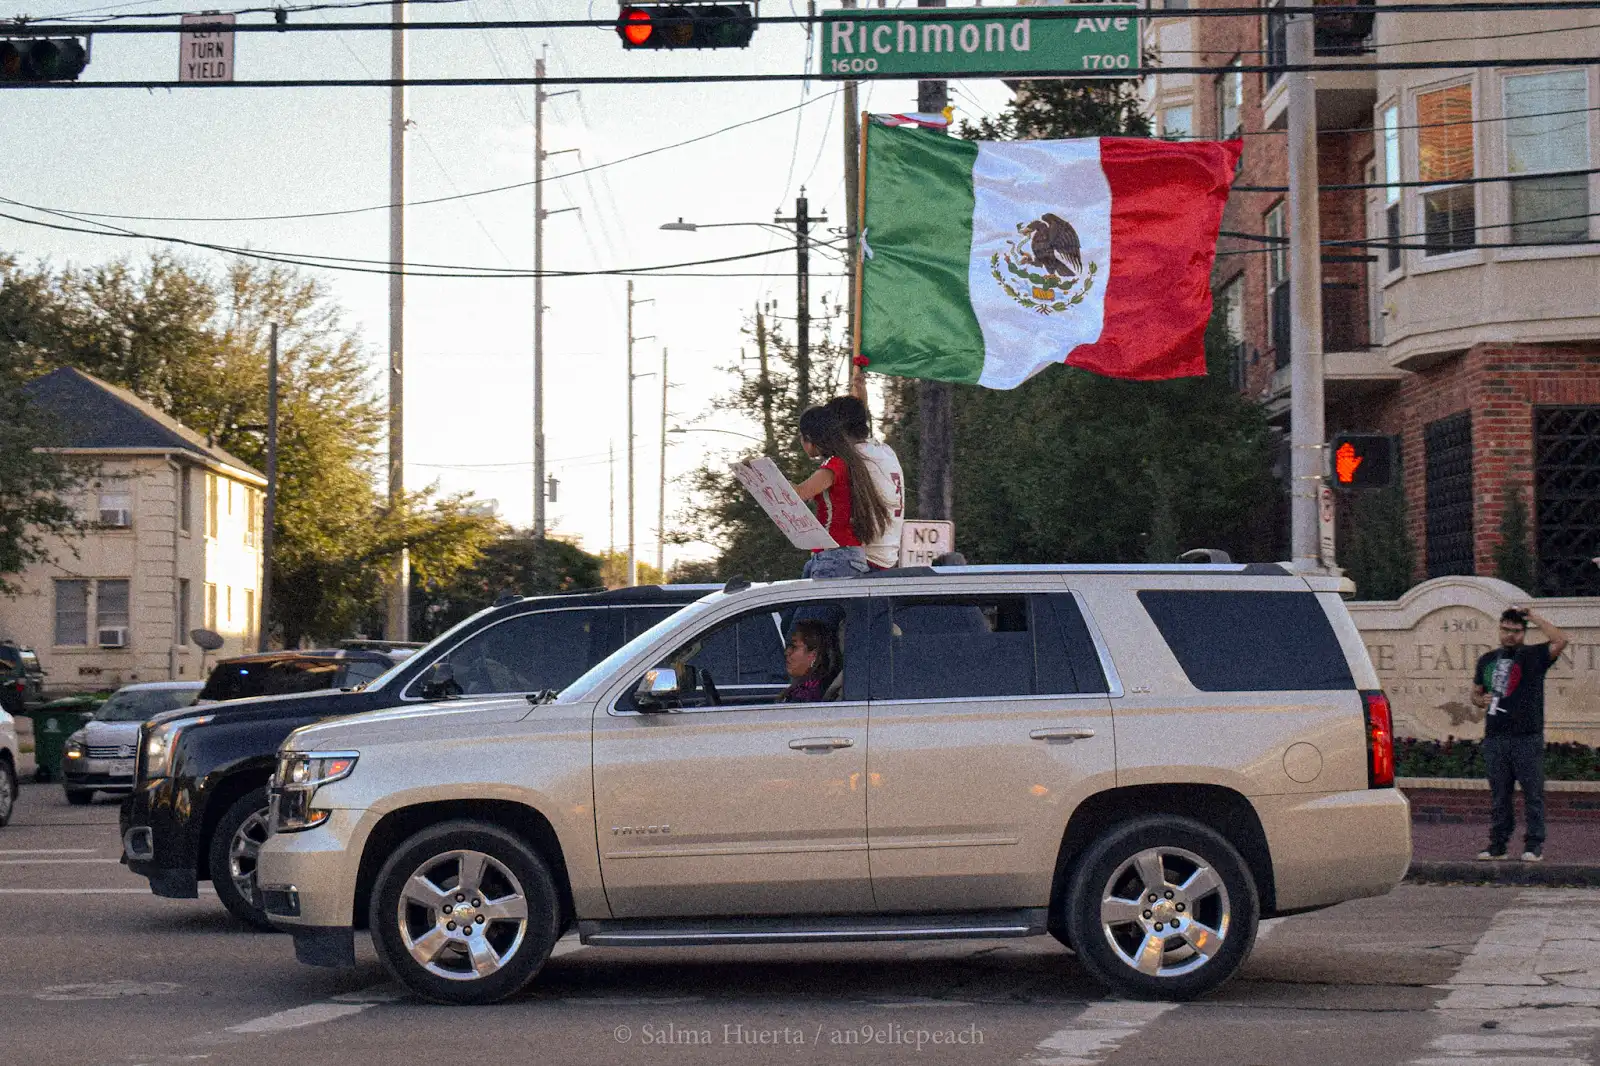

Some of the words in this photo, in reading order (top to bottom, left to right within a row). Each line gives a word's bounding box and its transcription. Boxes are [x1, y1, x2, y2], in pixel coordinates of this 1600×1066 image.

[831, 19, 1031, 53] Richmond
[1074, 17, 1130, 33] Ave
[191, 42, 224, 58] TURN
[188, 62, 225, 78] YIELD
[831, 58, 878, 73] 1600
[1082, 55, 1130, 69] 1700
[913, 528, 939, 544] NO
